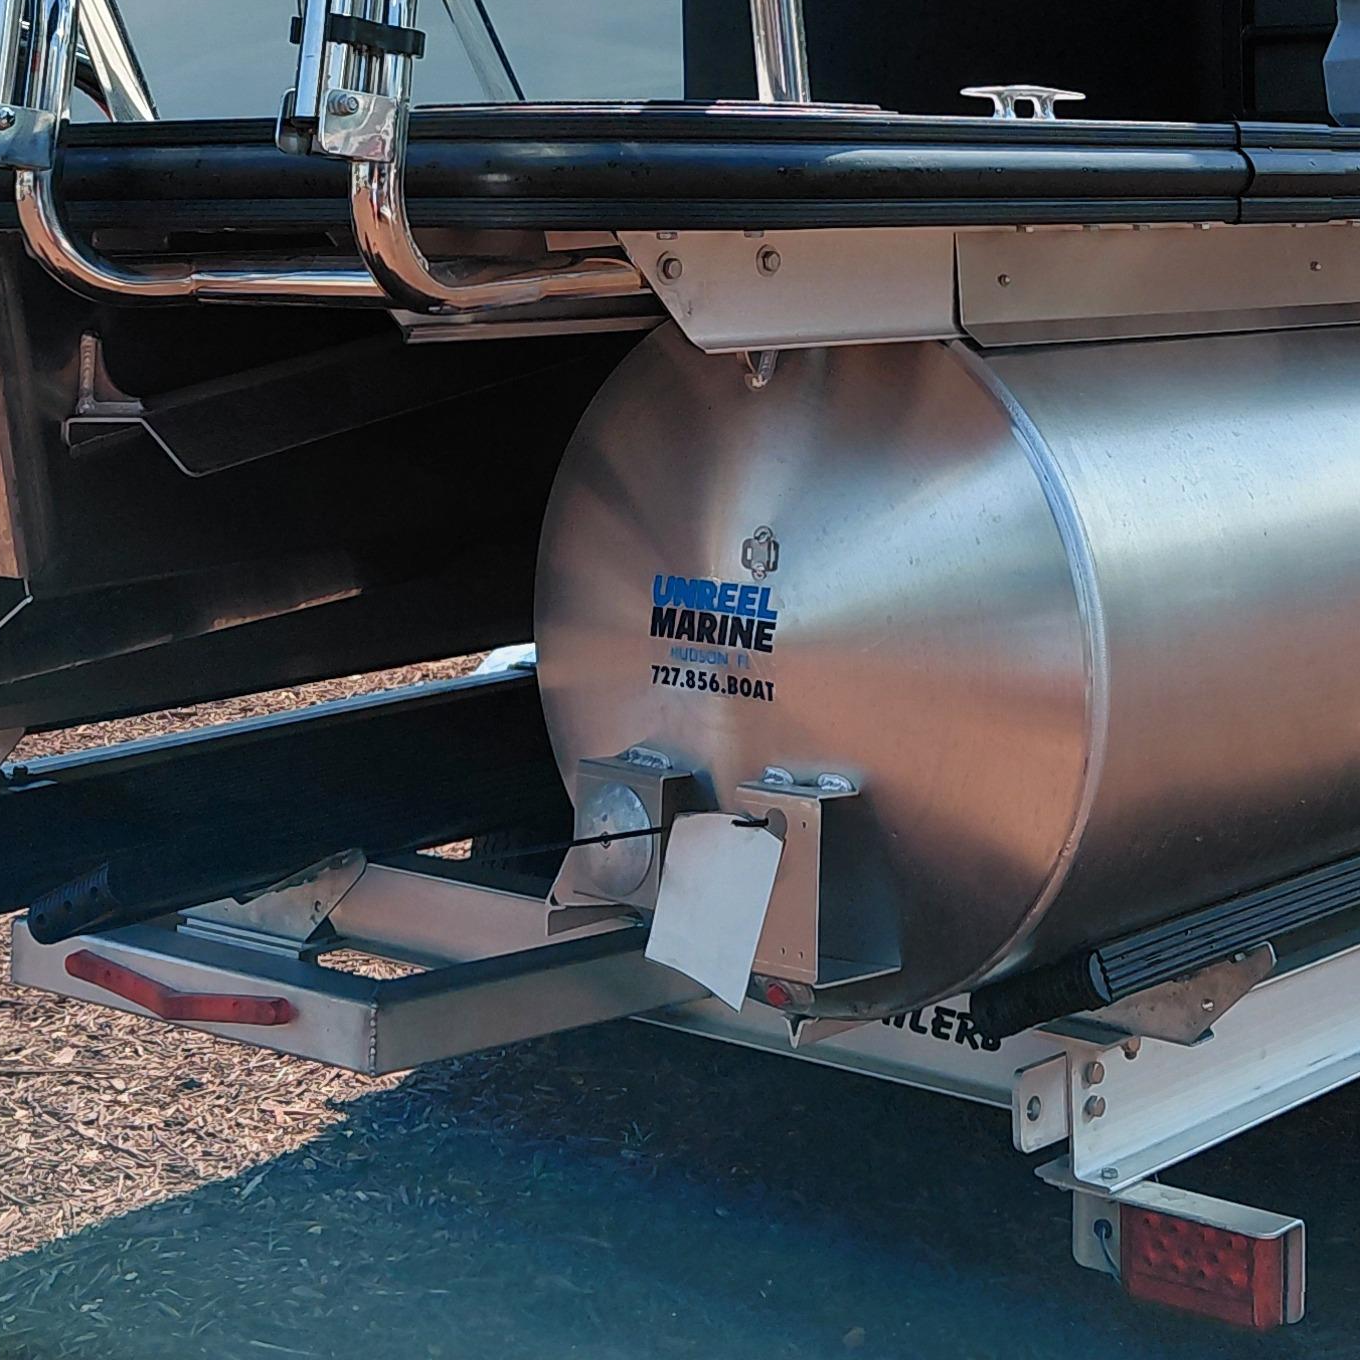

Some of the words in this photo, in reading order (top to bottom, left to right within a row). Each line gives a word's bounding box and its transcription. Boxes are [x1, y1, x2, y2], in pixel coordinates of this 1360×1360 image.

[653, 574, 778, 621] UNREEL
[650, 606, 777, 653] MARINE
[651, 664, 774, 702] 727.856.BOAT
